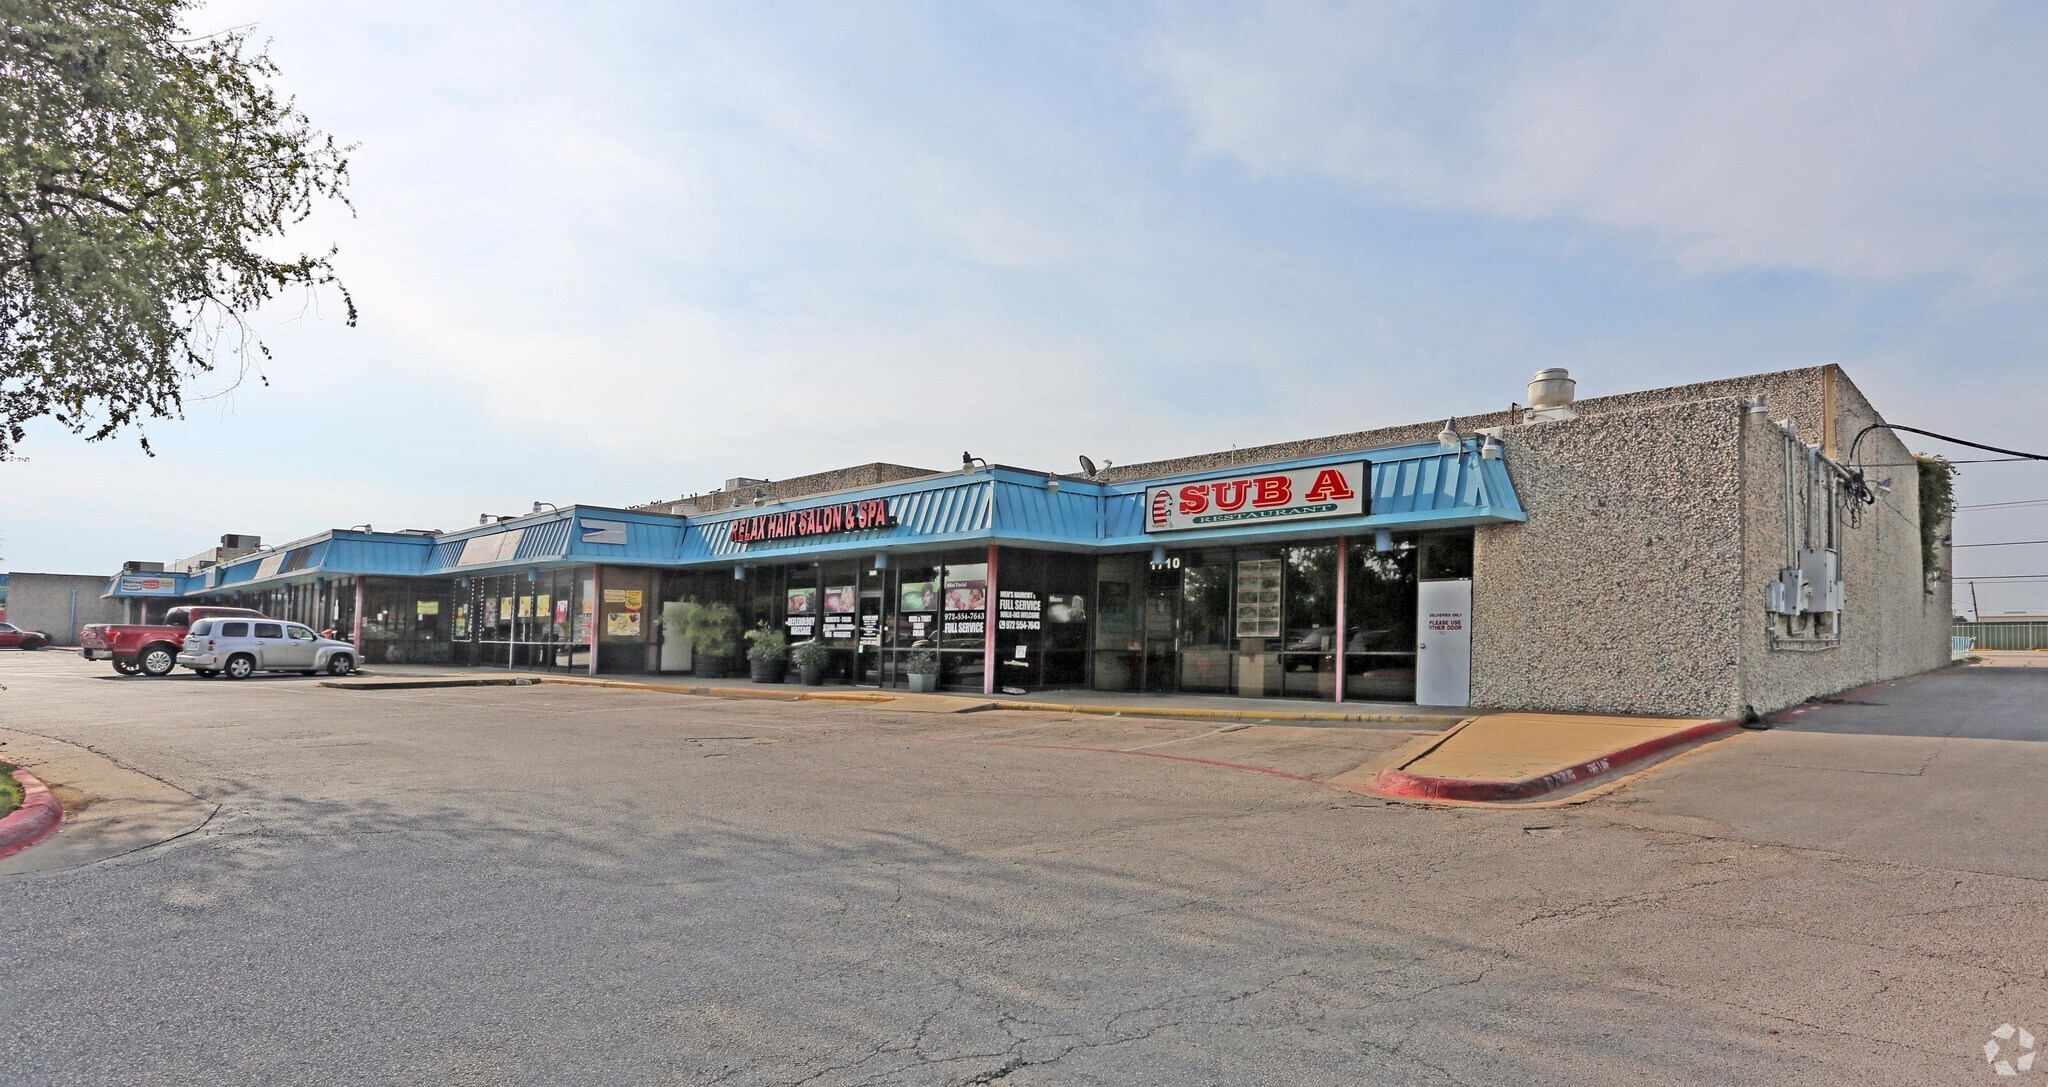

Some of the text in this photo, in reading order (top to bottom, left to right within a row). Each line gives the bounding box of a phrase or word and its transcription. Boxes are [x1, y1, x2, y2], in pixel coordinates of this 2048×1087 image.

[1179, 469, 1355, 515] SUB A
[1200, 504, 1333, 524] RESTAURANT
[731, 500, 886, 542] RELAX HAIR SALON & SPA
[1000, 600, 1041, 611] FULL SERVICE
[944, 612, 985, 621] 972-554-7643
[1021, 611, 1040, 619] WELCOME
[945, 622, 984, 634] FULL SERVICE
[1006, 621, 1040, 630] 972 554-7643
